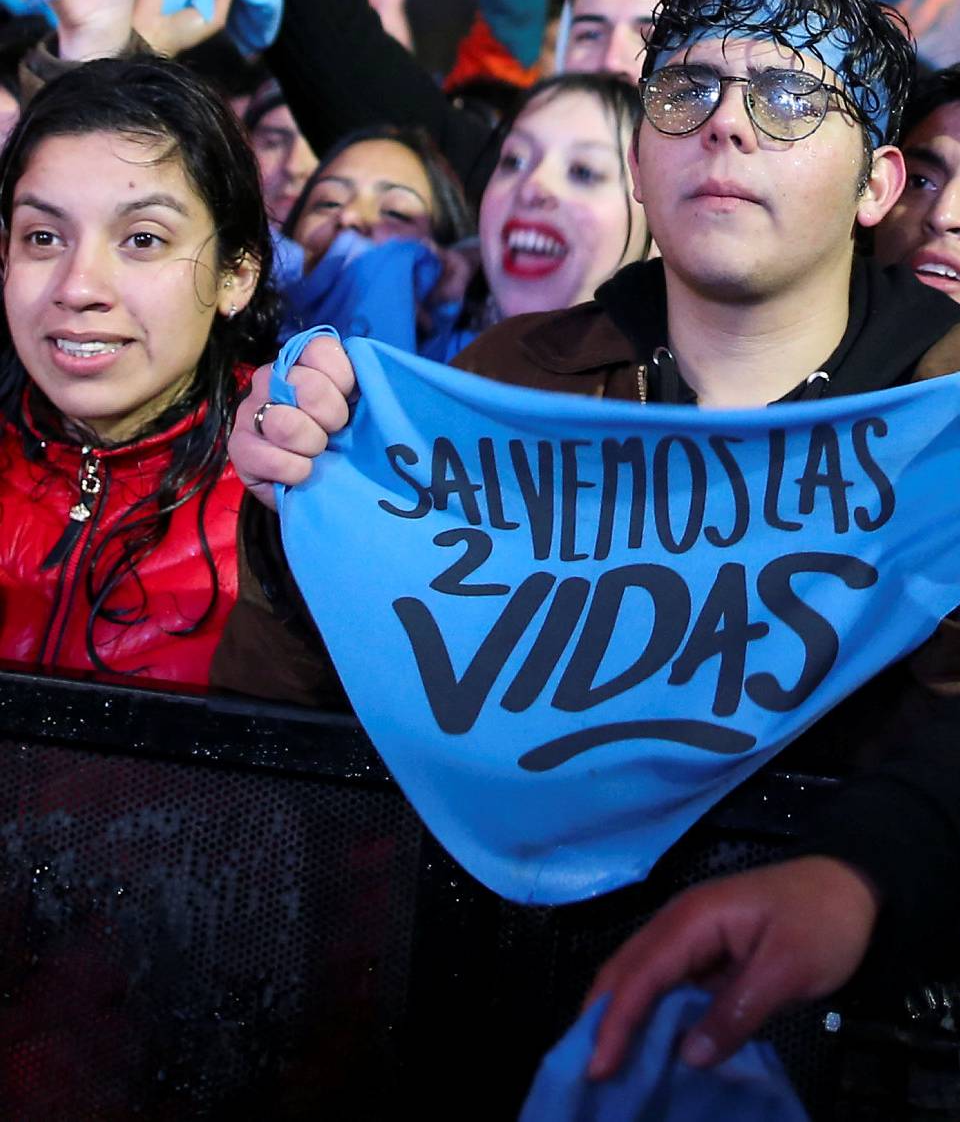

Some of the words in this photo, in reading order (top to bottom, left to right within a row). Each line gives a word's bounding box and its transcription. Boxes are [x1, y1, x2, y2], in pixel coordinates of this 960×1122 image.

[377, 433, 750, 562] SALVEMOS
[764, 417, 896, 534] LAS
[429, 528, 511, 597] 2
[391, 552, 879, 736] VIDAS
